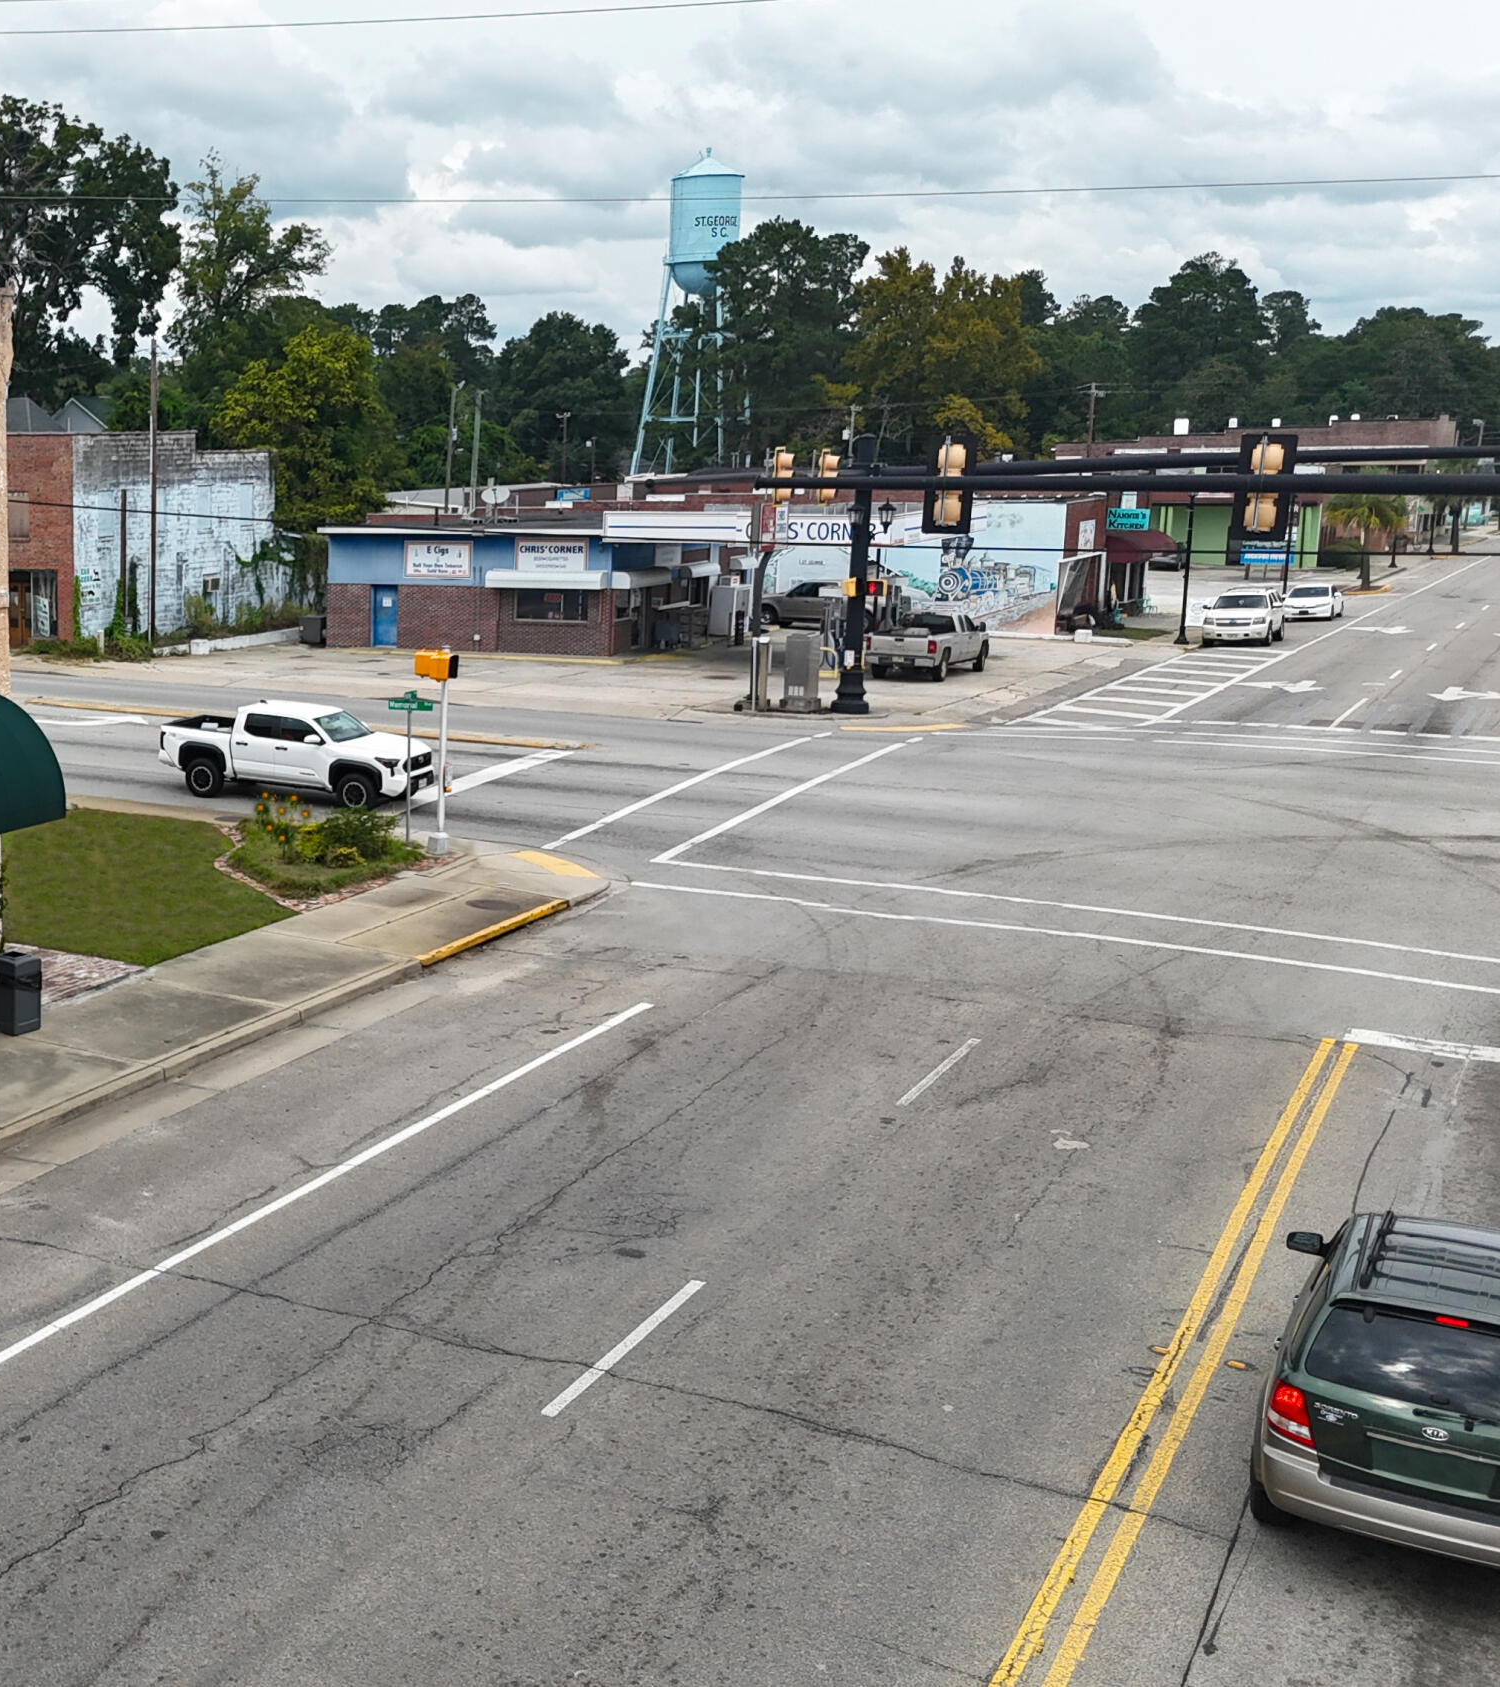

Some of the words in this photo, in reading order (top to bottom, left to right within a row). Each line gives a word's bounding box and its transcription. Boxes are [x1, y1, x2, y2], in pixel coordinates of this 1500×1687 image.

[1108, 519, 1145, 529] KITCHEN
[806, 522, 877, 541] CORNR
[427, 545, 432, 554] E
[434, 545, 449, 557] Cigs
[549, 545, 583, 554] CORNER
